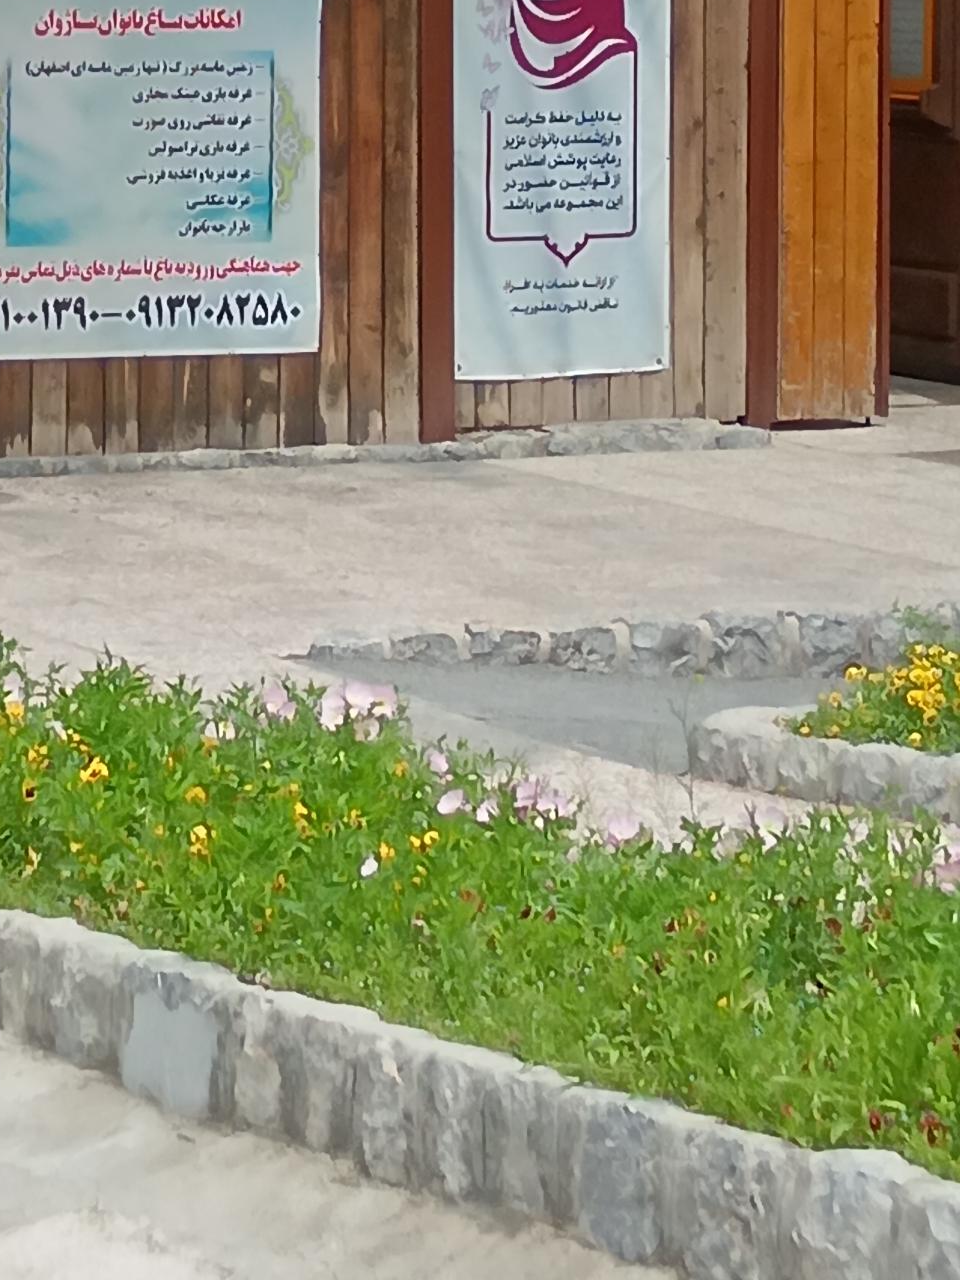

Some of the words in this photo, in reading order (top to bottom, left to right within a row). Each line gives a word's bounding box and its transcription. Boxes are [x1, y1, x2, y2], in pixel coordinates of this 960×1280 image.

[99, 7, 143, 36] بانوان
[184, 8, 241, 30] امکانات
[504, 111, 547, 128] کرامت
[548, 110, 574, 124] حفظ
[575, 110, 605, 126] دلیل
[606, 111, 622, 126] به
[502, 134, 527, 150] عزیز
[528, 131, 560, 150] بانوان
[560, 128, 614, 148] ارزشمندی
[504, 153, 546, 171] اسلامی
[547, 153, 588, 171] پوشش
[589, 152, 622, 168] رعایت
[502, 178, 517, 192] در
[559, 171, 611, 191] قوانین
[610, 172, 621, 189] از
[185, 194, 225, 211] عکاسی
[503, 195, 534, 214] باشد
[535, 201, 552, 213] می
[553, 198, 604, 212] مجموعه
[606, 194, 624, 211] این
[271, 260, 301, 277] جهت
